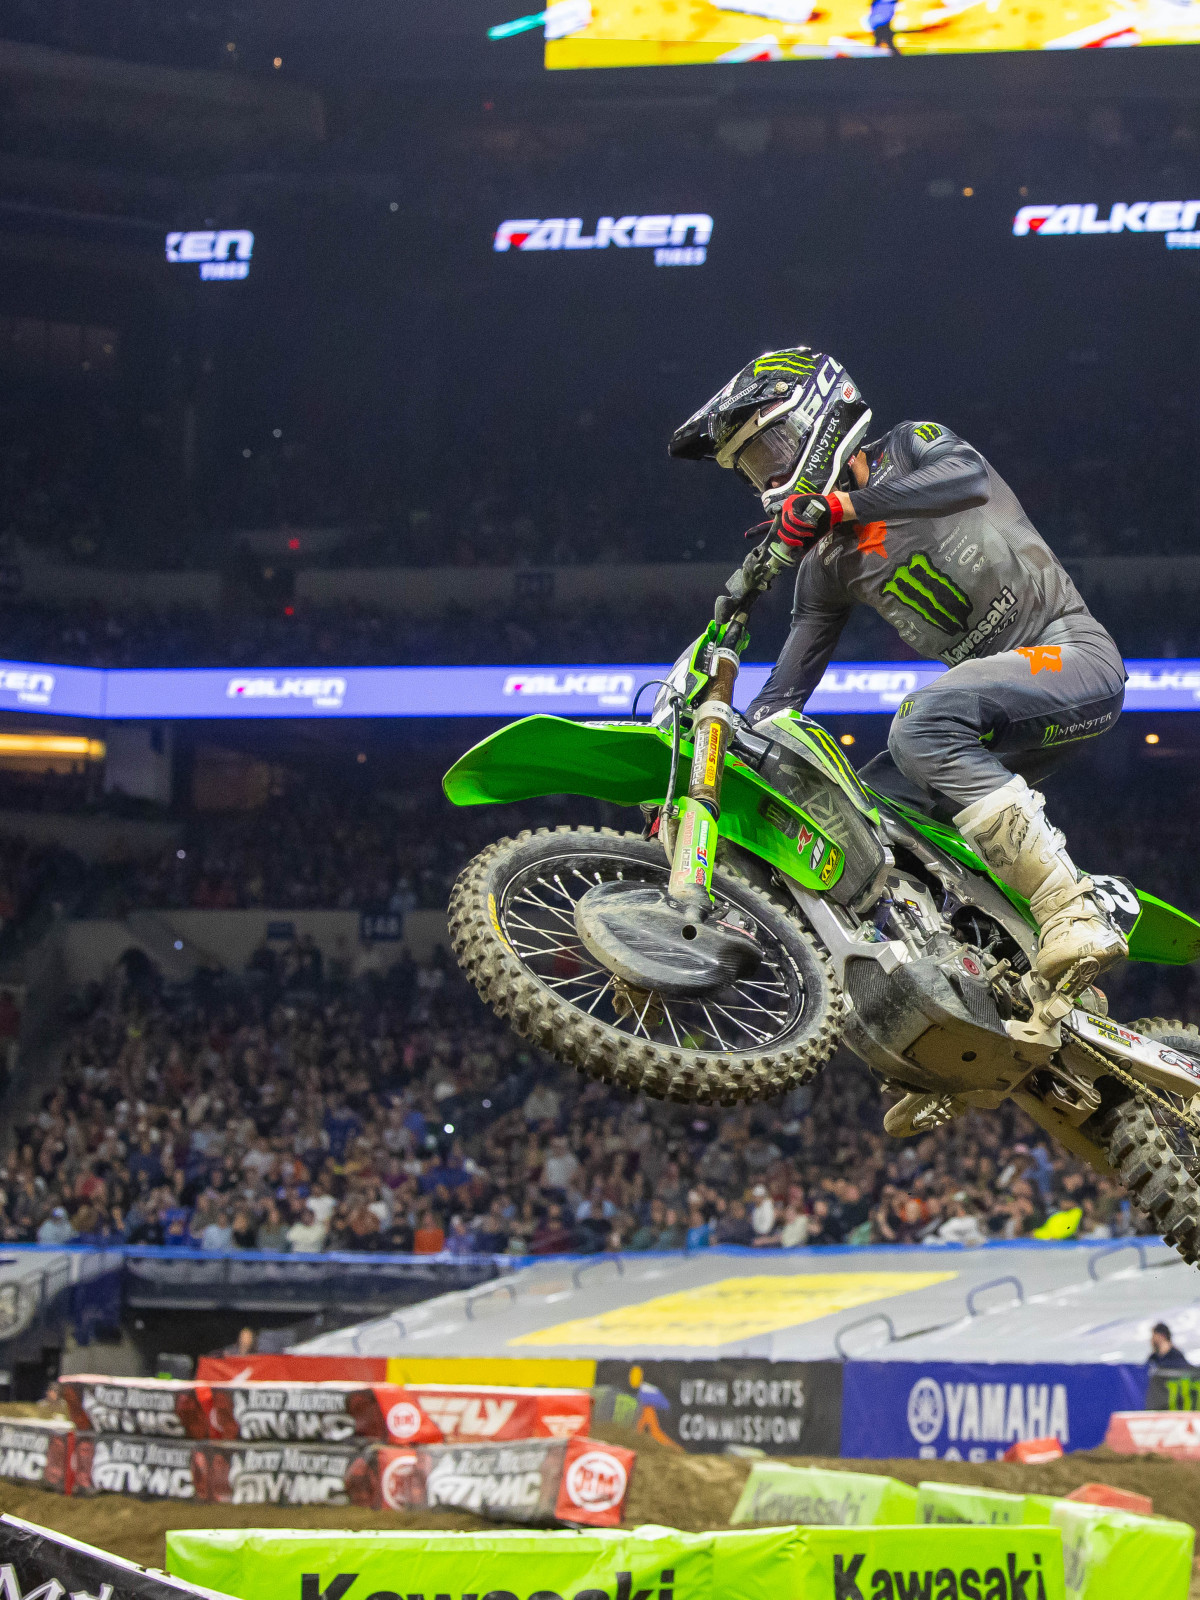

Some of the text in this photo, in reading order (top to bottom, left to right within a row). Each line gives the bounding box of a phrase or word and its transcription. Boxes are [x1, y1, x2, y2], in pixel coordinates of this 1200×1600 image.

[493, 213, 713, 252] FALKEN
[940, 588, 1016, 666] Kawasaki
[708, 727, 720, 765] SHOWA
[680, 1379, 804, 1407] UTAH SPORTS
[943, 1382, 1069, 1443] YAMAHA
[679, 1413, 801, 1443] COMMISSION
[833, 1553, 1048, 1600] Kawasaki
